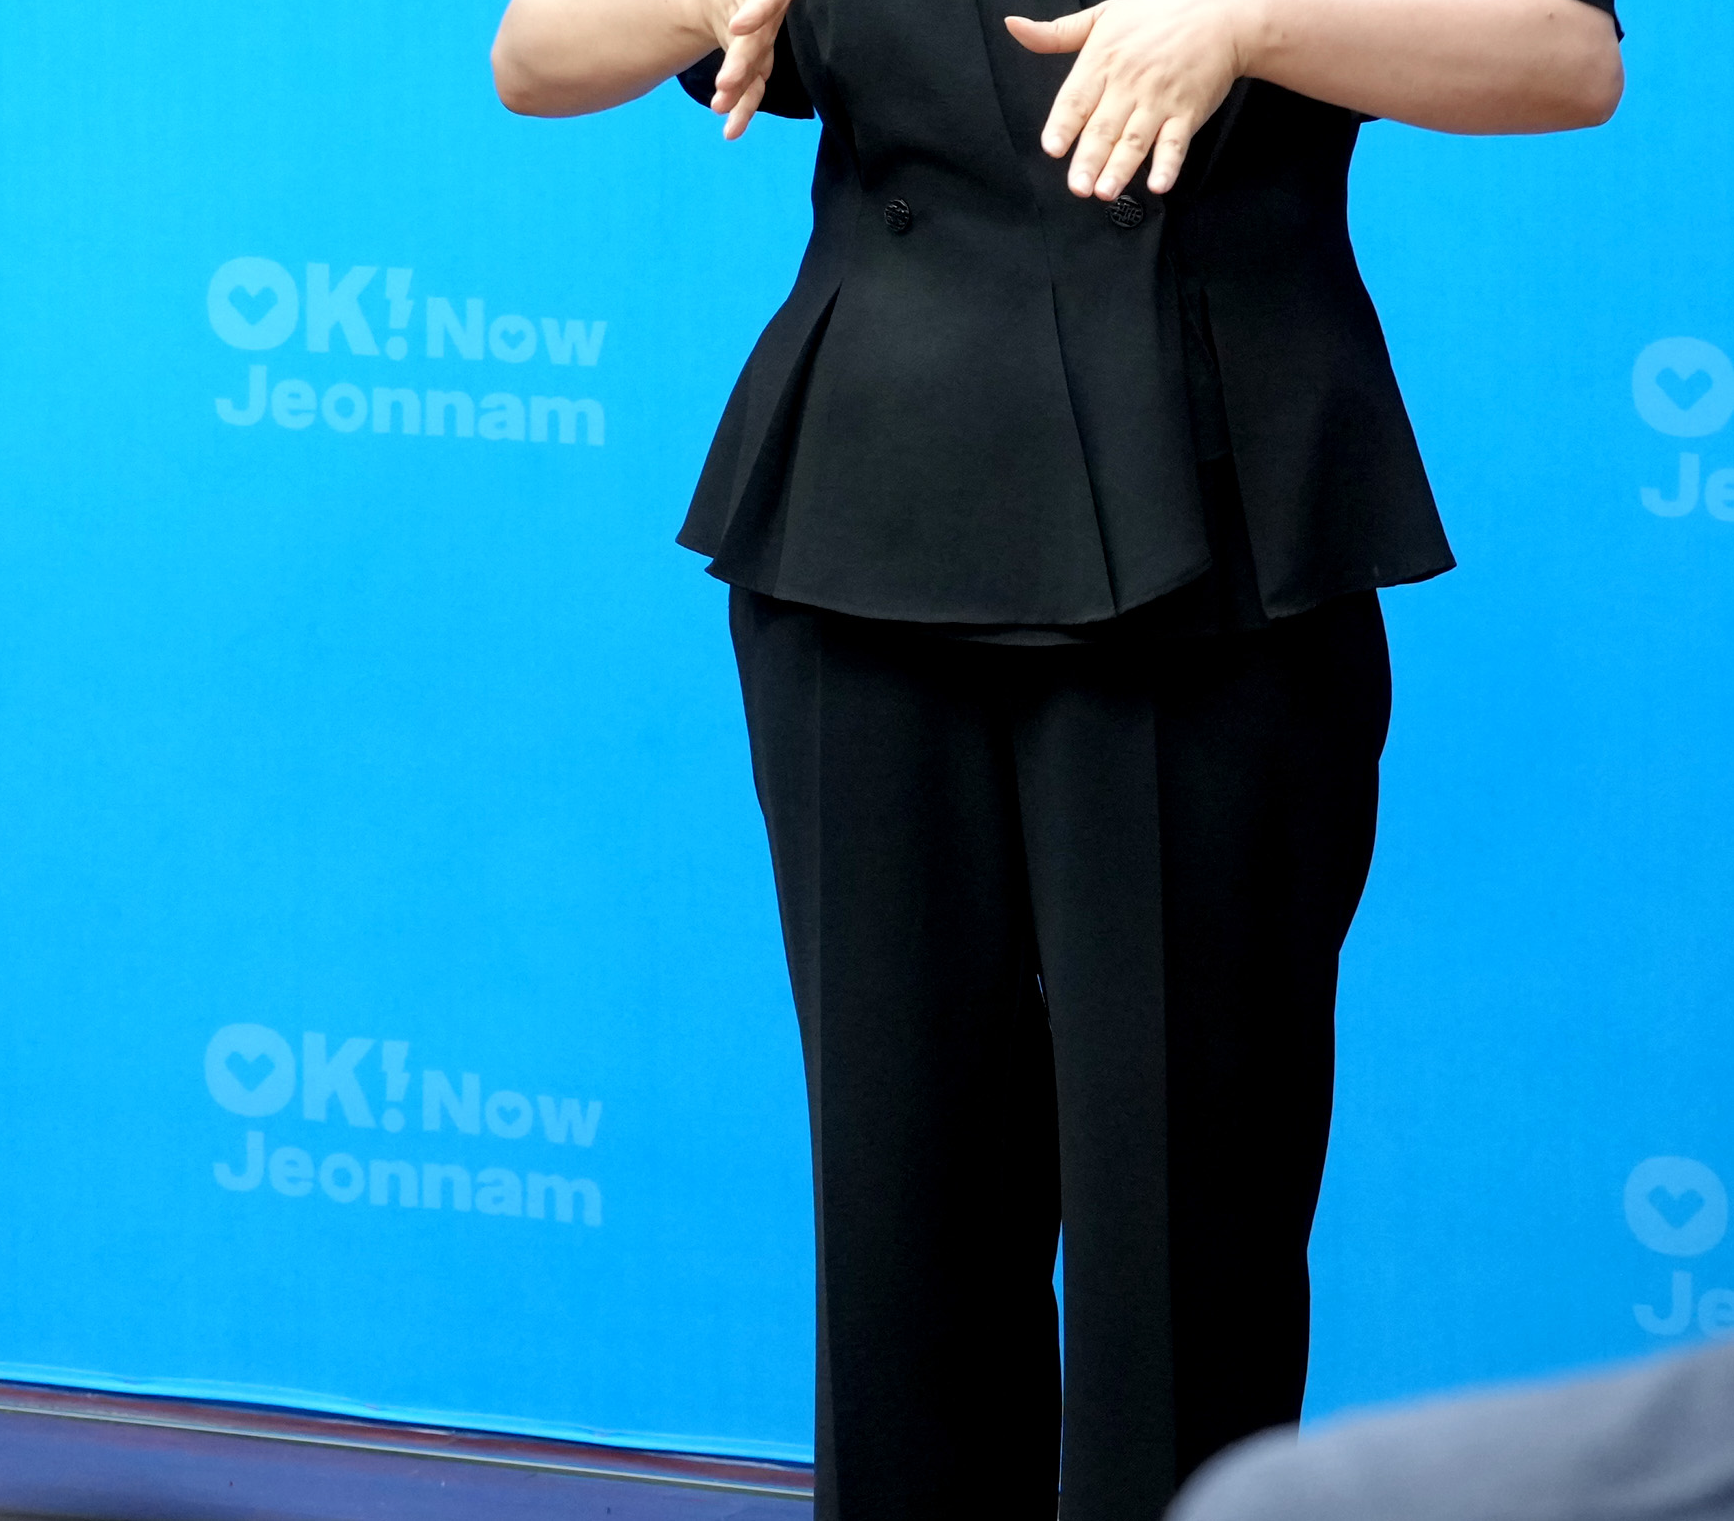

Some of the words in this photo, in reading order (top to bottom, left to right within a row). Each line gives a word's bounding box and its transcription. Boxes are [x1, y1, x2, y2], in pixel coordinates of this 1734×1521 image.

[425, 296, 609, 368] Now
[214, 364, 606, 448] Jeonnam
[419, 1069, 604, 1150] Now
[212, 1130, 604, 1228] Jeonnam
